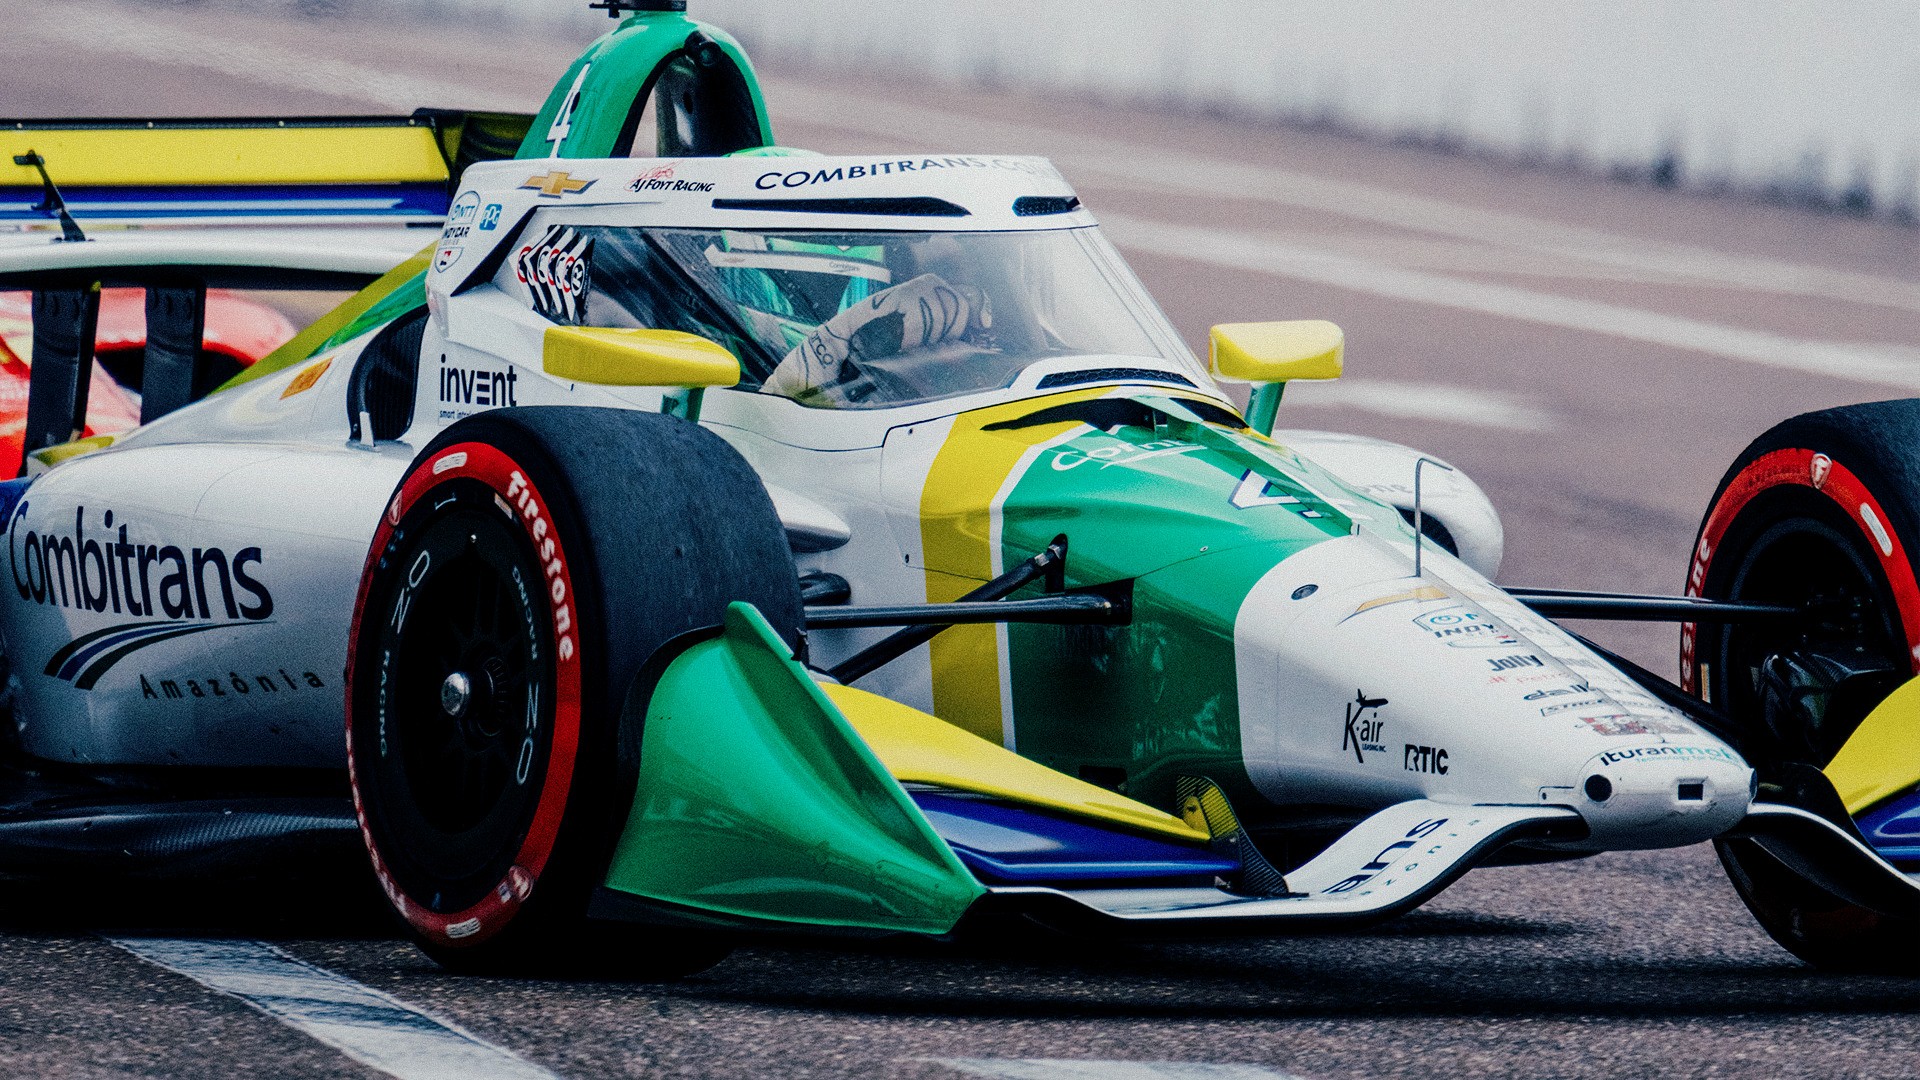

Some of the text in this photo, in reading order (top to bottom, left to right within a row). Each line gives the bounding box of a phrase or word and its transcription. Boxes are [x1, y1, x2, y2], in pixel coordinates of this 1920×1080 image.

[546, 61, 592, 158] 4
[629, 179, 715, 193] AJ FOYT RACING
[755, 157, 1050, 190] COMBITRANS.CO
[10, 500, 273, 621] Combitrans
[507, 470, 574, 662] Firestone
[1405, 744, 1448, 775] RTIC
